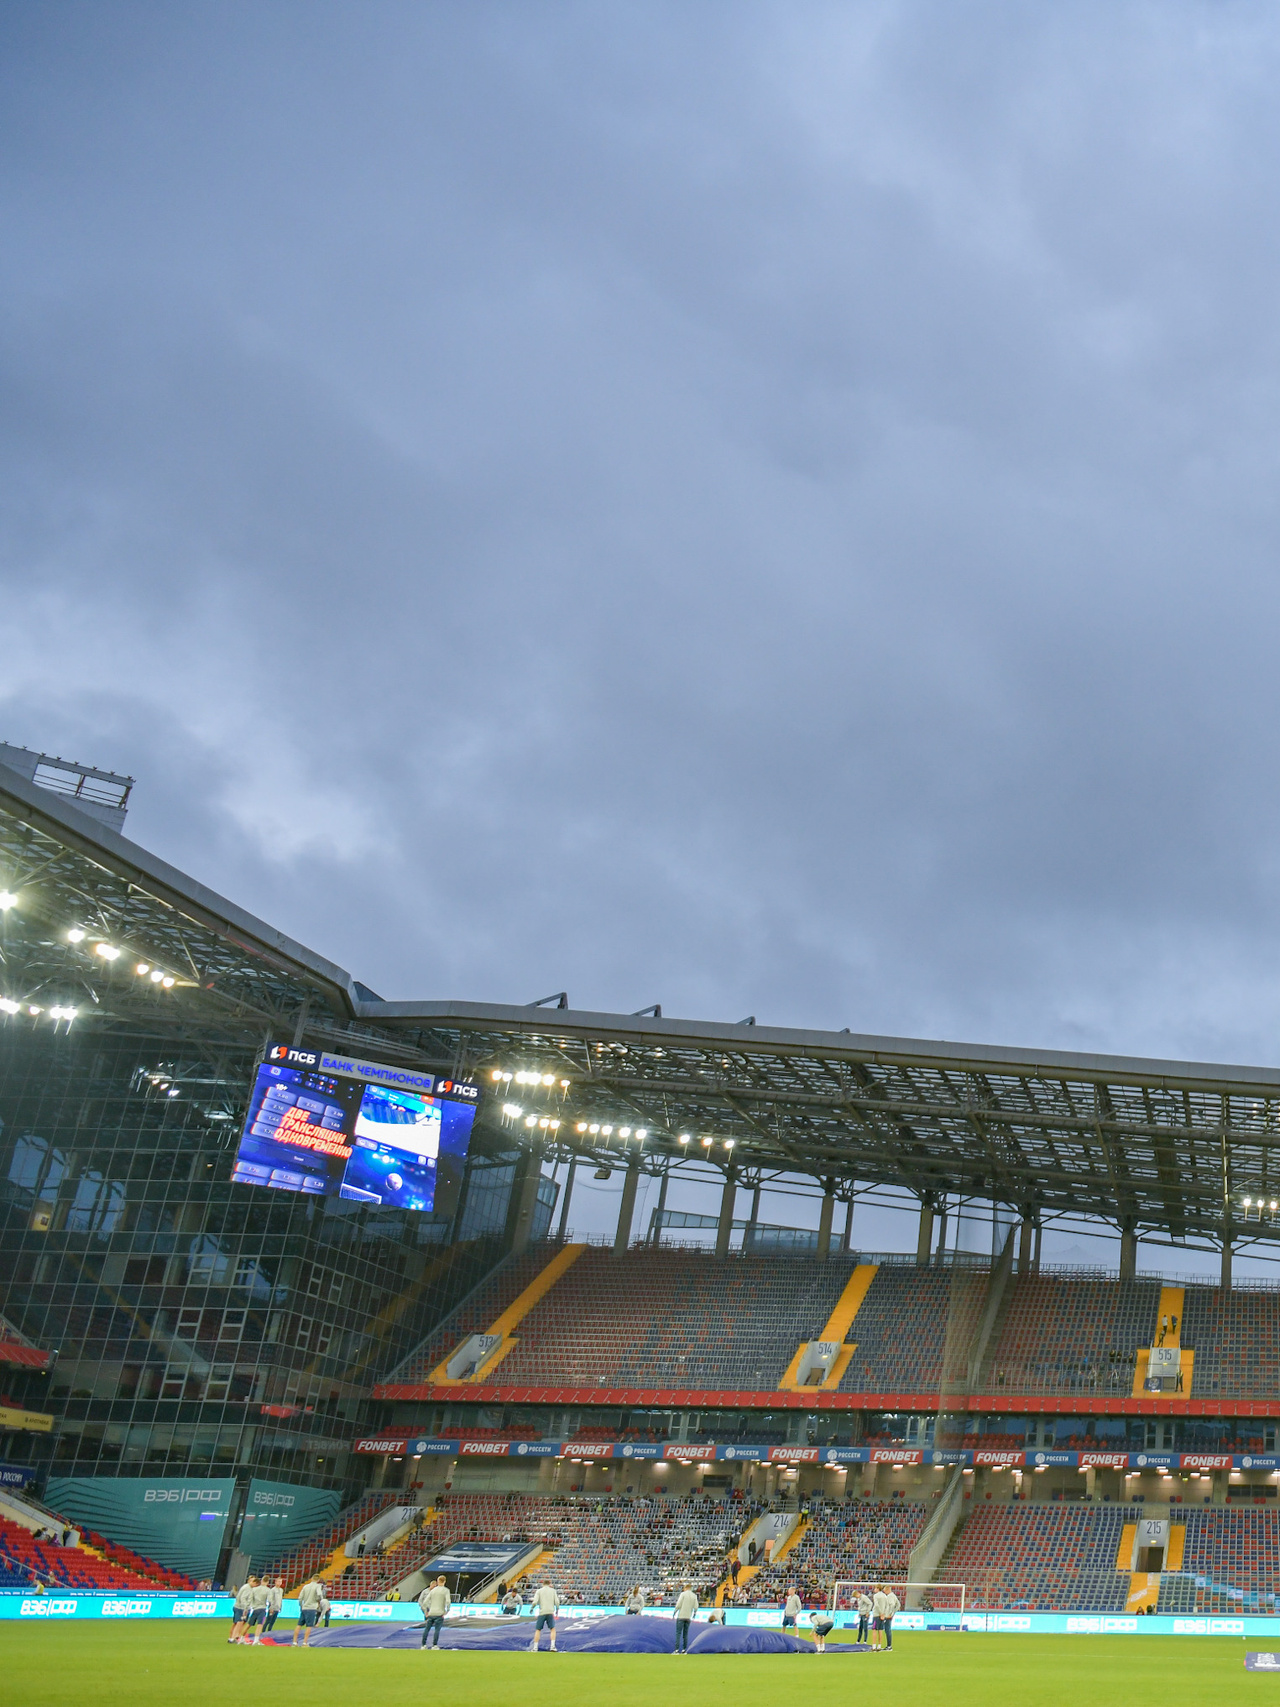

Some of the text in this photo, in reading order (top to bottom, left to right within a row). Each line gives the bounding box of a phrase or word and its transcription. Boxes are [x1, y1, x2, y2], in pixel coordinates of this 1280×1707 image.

[288, 1050, 316, 1065] ПСБ
[322, 1057, 431, 1089] БАНК ЧЕМПИОНОВ
[453, 1084, 478, 1098] ПСБ
[284, 1107, 310, 1121] ДВЕ
[280, 1117, 347, 1145] ТРАНСЛЯЦИИ
[274, 1128, 353, 1158] ОДНОВРЕМЕННО
[479, 1336, 493, 1347] 513
[818, 1342, 832, 1354] 514
[1158, 1349, 1172, 1360] 515
[357, 1441, 403, 1452] FONBET
[462, 1443, 508, 1453] FONBET
[564, 1445, 610, 1455] FONBET
[666, 1446, 713, 1457] FONBET
[771, 1448, 817, 1459] FONBET
[873, 1450, 919, 1461] FONBET
[976, 1452, 1022, 1463] FONBET
[1081, 1454, 1128, 1465] FONBET
[1183, 1456, 1229, 1467] FONBET
[774, 1515, 789, 1528] 214
[1147, 1521, 1161, 1534] 215
